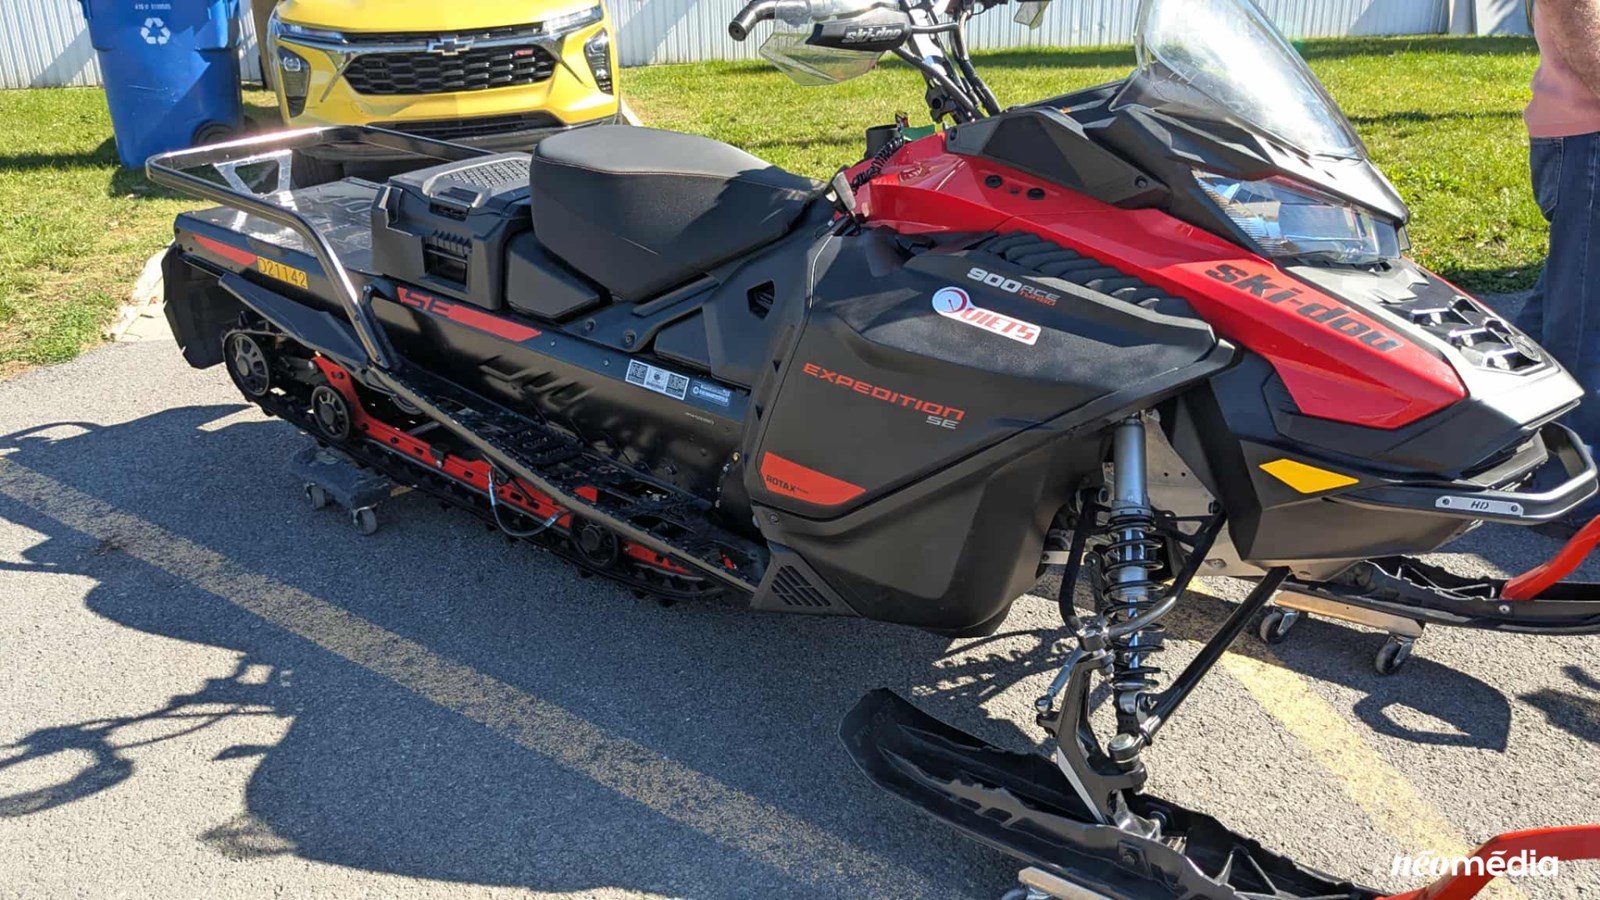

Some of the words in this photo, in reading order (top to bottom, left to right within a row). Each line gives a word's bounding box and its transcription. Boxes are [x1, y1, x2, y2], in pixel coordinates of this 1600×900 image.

[967, 267, 1022, 293] 900
[803, 362, 965, 421] EXPEDITION
[926, 415, 960, 429] SE
[1471, 500, 1490, 510] HD
